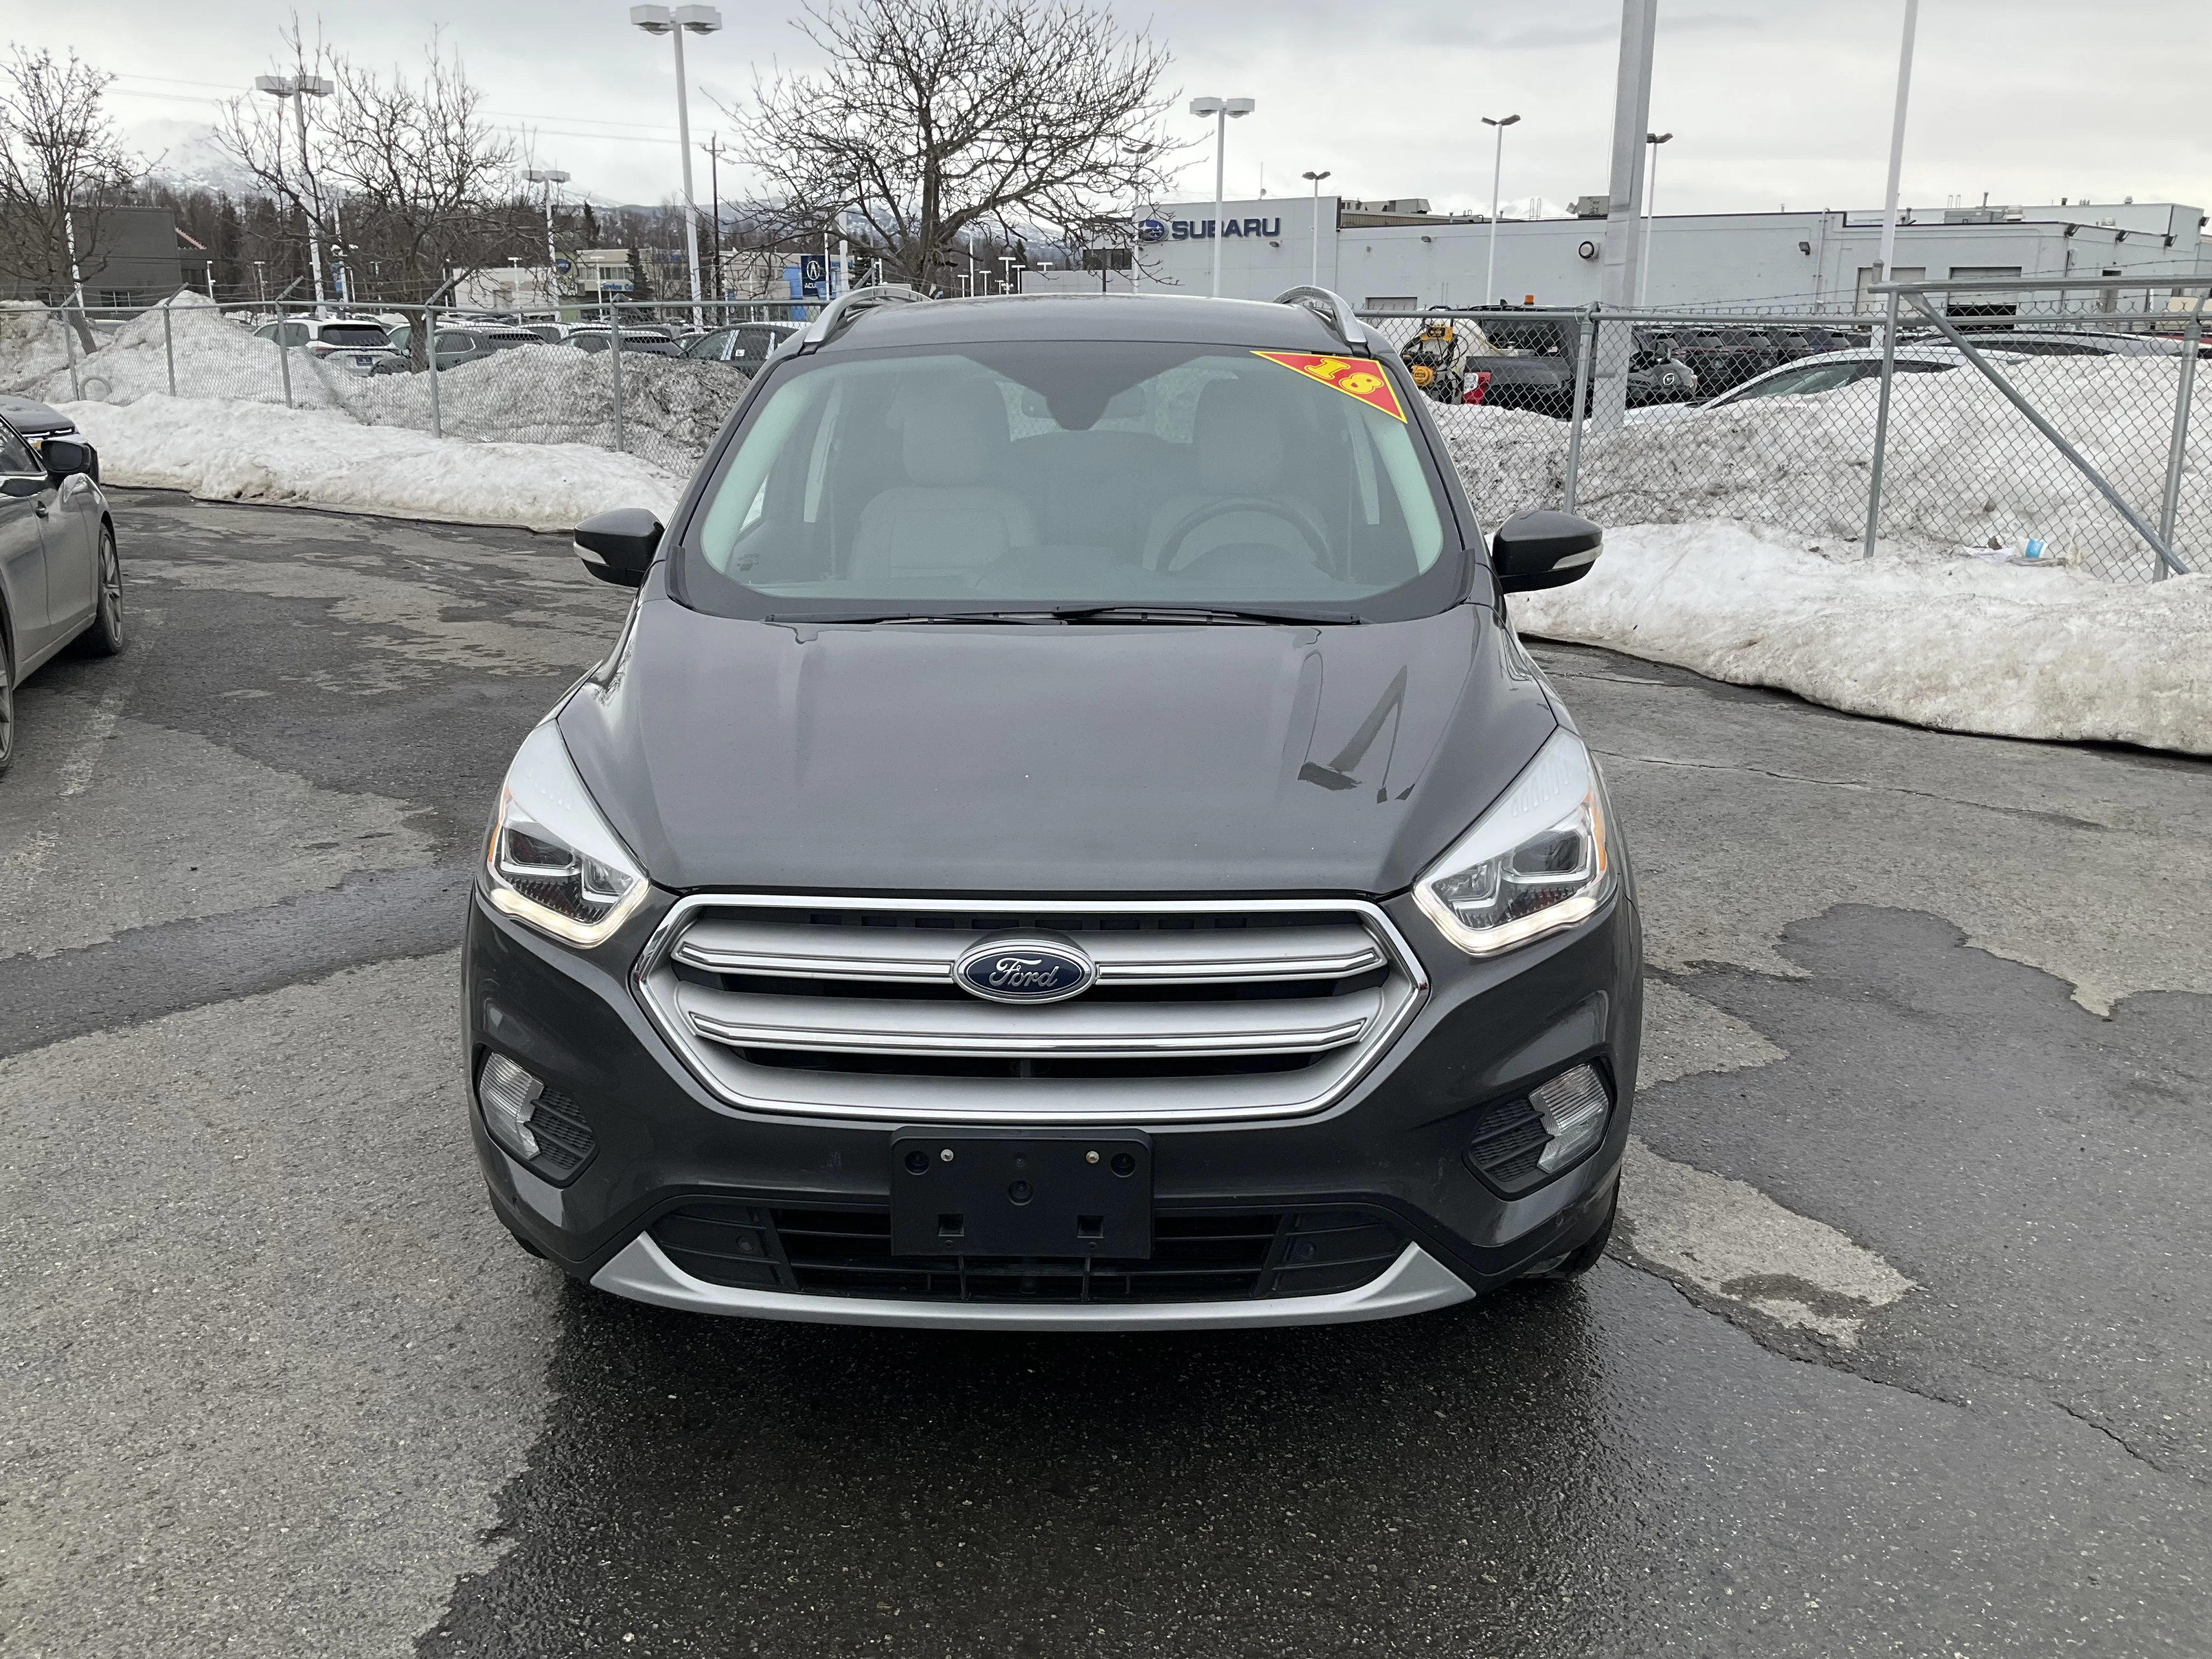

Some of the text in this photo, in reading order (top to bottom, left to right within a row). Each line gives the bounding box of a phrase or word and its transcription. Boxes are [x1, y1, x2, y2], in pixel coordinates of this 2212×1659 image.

[1172, 218, 1280, 239] SUBARU
[1304, 358, 1384, 394] 18
[989, 957, 1060, 987] Ford
